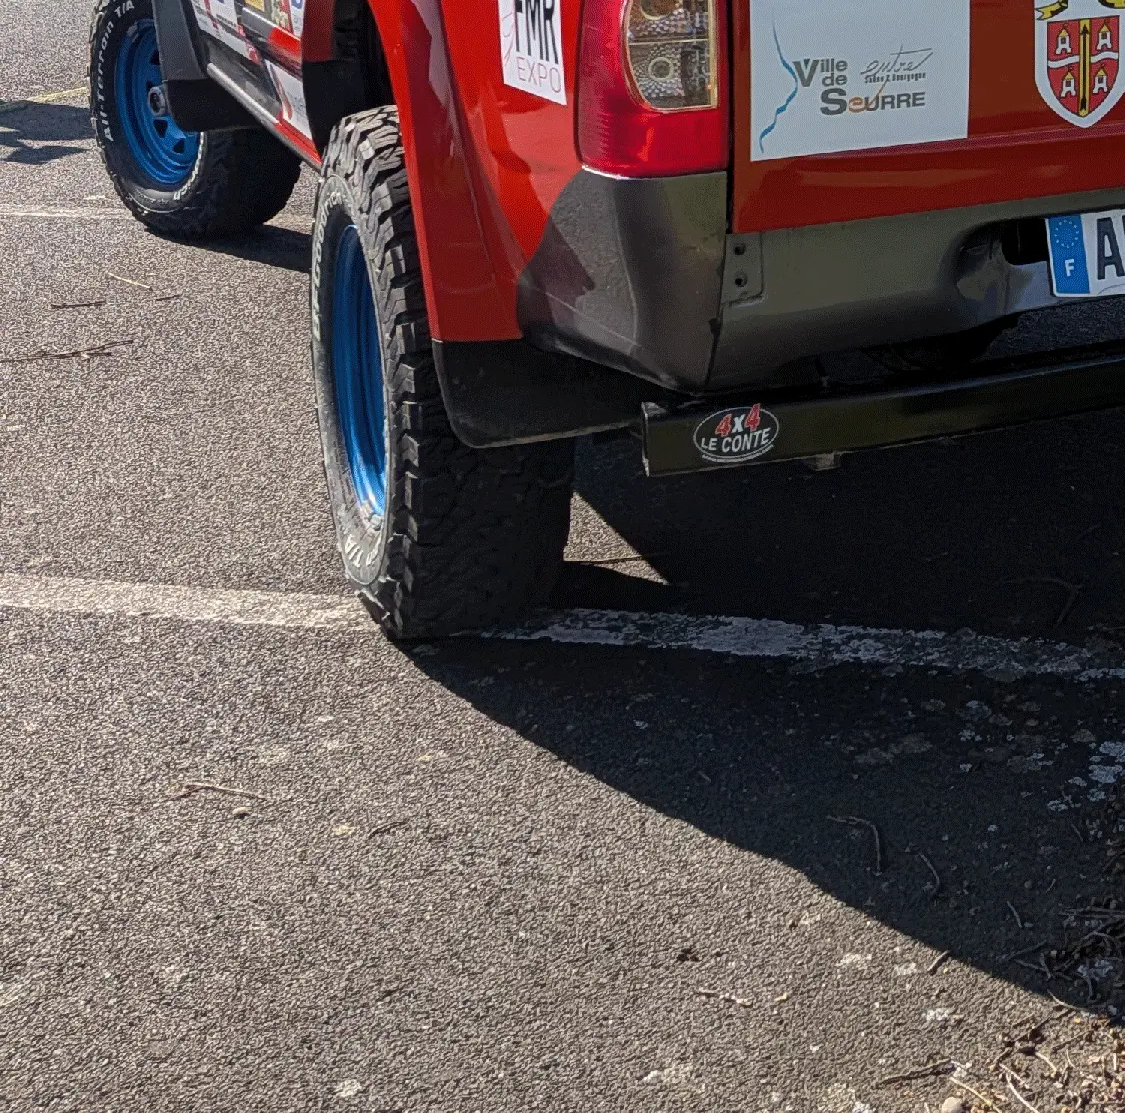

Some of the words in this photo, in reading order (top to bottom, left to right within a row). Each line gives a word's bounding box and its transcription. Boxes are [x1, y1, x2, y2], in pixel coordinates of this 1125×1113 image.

[516, 56, 562, 94] EXPO
[792, 58, 848, 88] Ville
[821, 73, 848, 86] de
[1064, 259, 1075, 277] F
[701, 437, 717, 451] LE
[721, 427, 771, 453] CONTE
